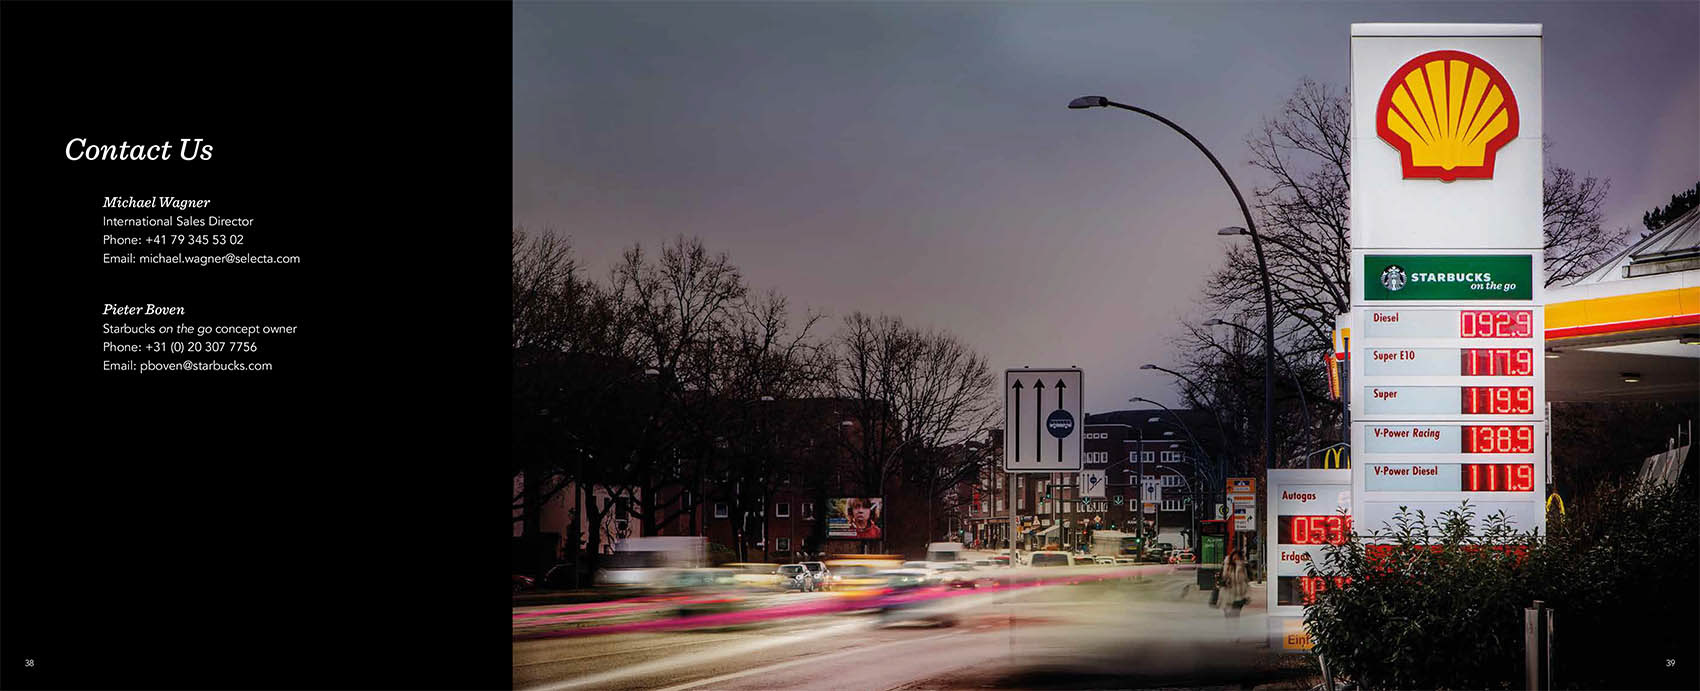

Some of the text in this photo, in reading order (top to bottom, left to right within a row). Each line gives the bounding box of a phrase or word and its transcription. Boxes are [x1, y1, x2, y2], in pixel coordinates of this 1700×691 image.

[1411, 272, 1492, 283] STARBUCKS
[1486, 281, 1502, 290] the
[1503, 283, 1517, 292] go
[1373, 311, 1531, 337] Diesel 092.9
[1373, 350, 1531, 375] Super E10 117.9
[1373, 388, 1532, 413] Super 119.9
[1374, 427, 1532, 452] V-Power Racing 138.9
[1374, 465, 1532, 491] V-Power Diesel 111.9
[1282, 490, 1317, 503] Autogas
[1281, 551, 1311, 564] Erdga
